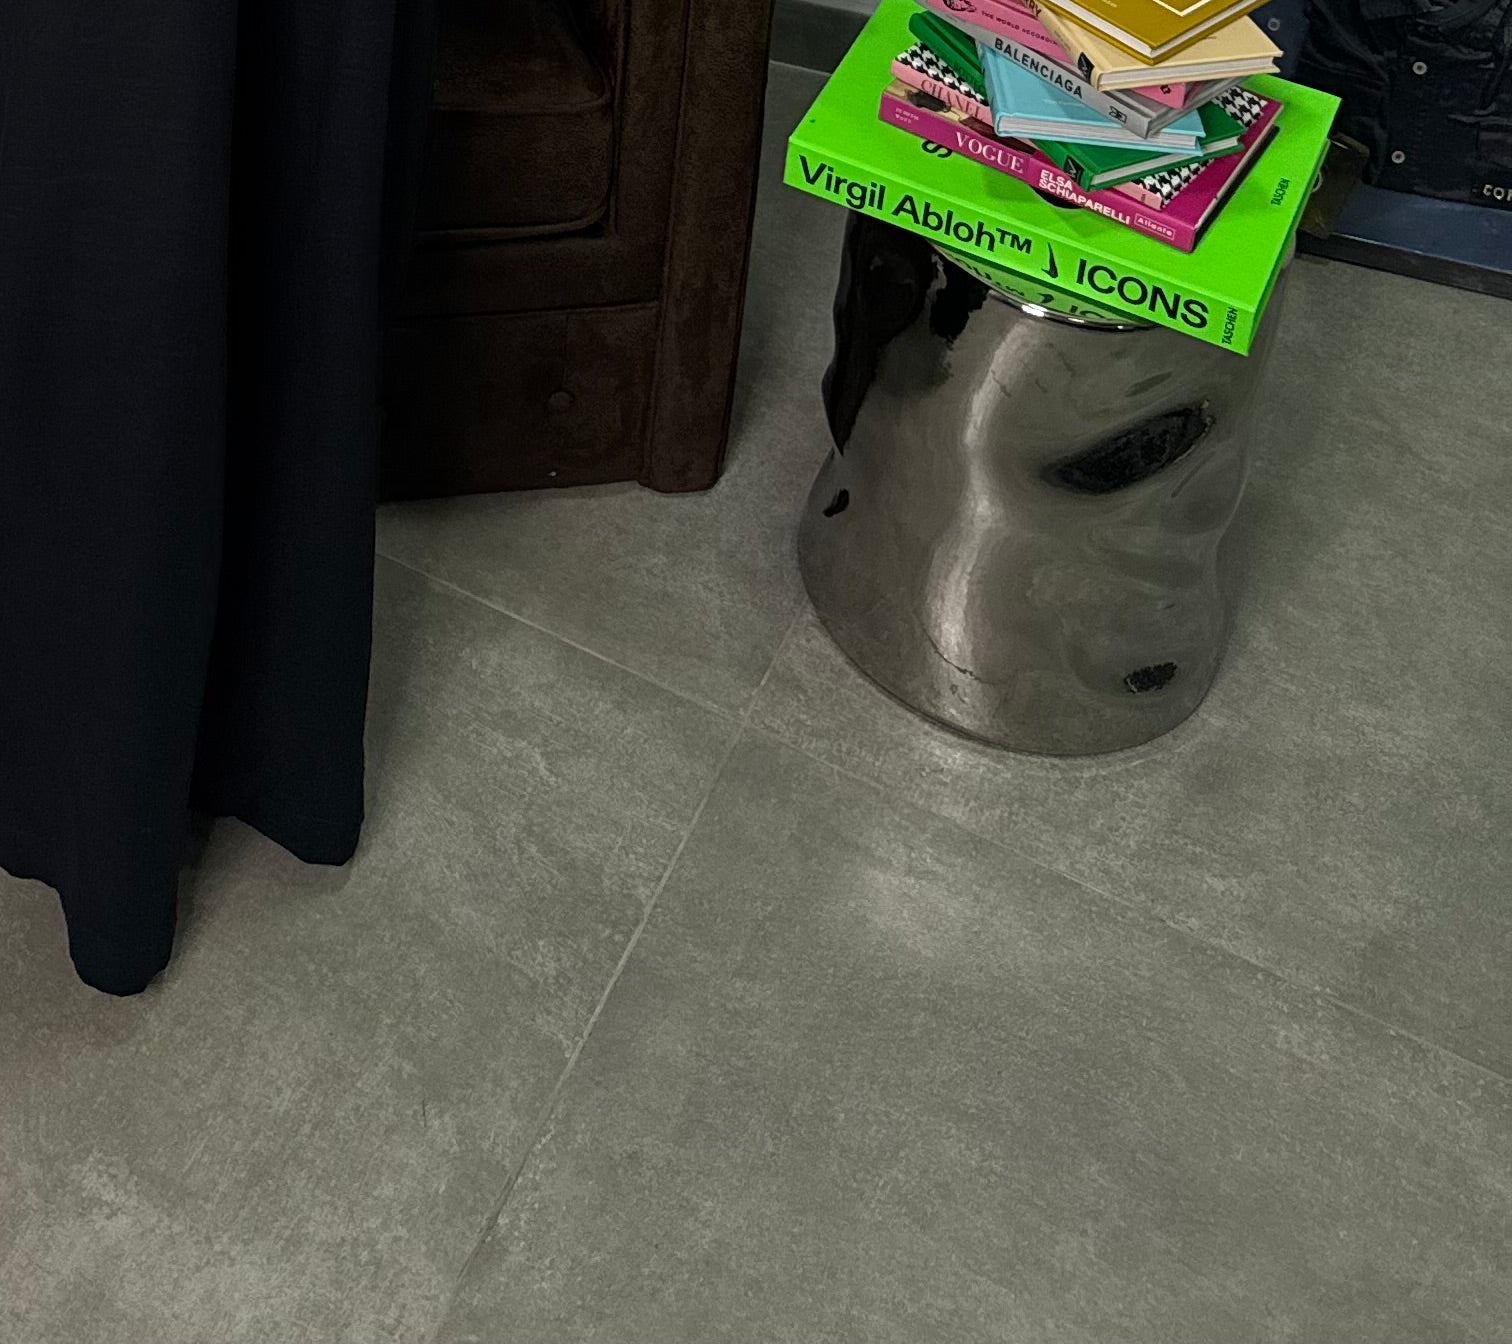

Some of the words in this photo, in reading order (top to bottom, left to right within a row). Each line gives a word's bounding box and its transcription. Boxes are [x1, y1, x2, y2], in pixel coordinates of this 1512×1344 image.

[994, 37, 1083, 99] BALENCIAGA
[955, 131, 1025, 174] VOGUE
[1038, 178, 1131, 225] SCHIAPARELLI
[1040, 168, 1073, 191] ELSA
[798, 154, 886, 210] Virgil
[1076, 258, 1209, 329] ICONS
[1222, 306, 1238, 345] TASCHEN
